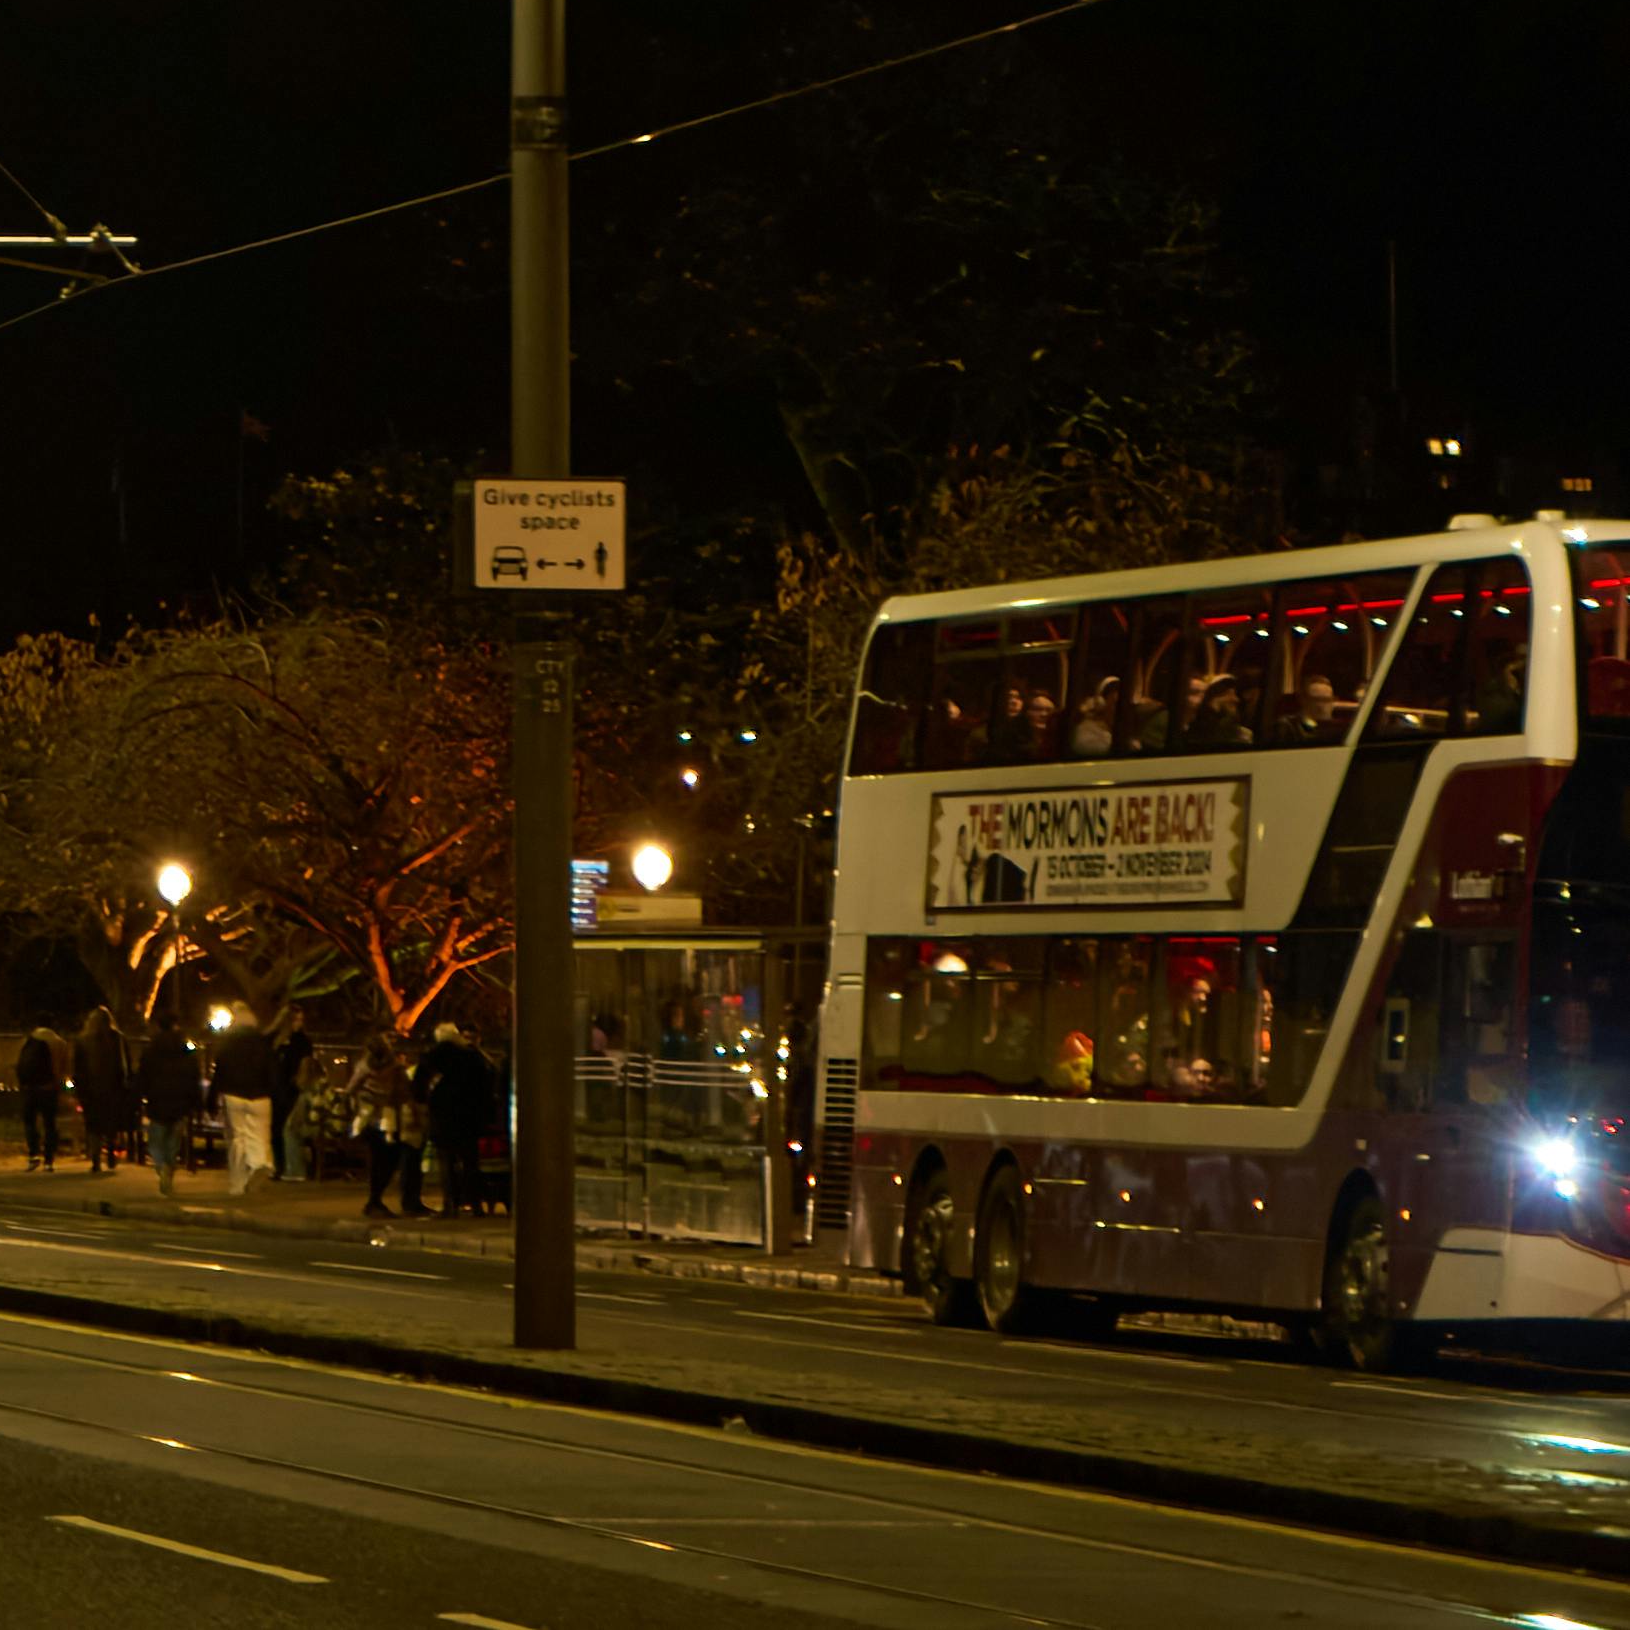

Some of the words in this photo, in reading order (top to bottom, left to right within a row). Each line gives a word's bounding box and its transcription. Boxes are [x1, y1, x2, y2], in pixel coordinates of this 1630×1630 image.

[483, 488, 530, 506] Give
[535, 488, 615, 509] cyclists
[520, 516, 580, 532] space
[969, 803, 1004, 851] THE
[1006, 797, 1109, 850] MORMONS
[1111, 796, 1152, 846] ARE
[1155, 792, 1216, 844] BACK!
[1060, 854, 1107, 878] OCTOBER
[1124, 851, 1182, 877] NOVEMBER
